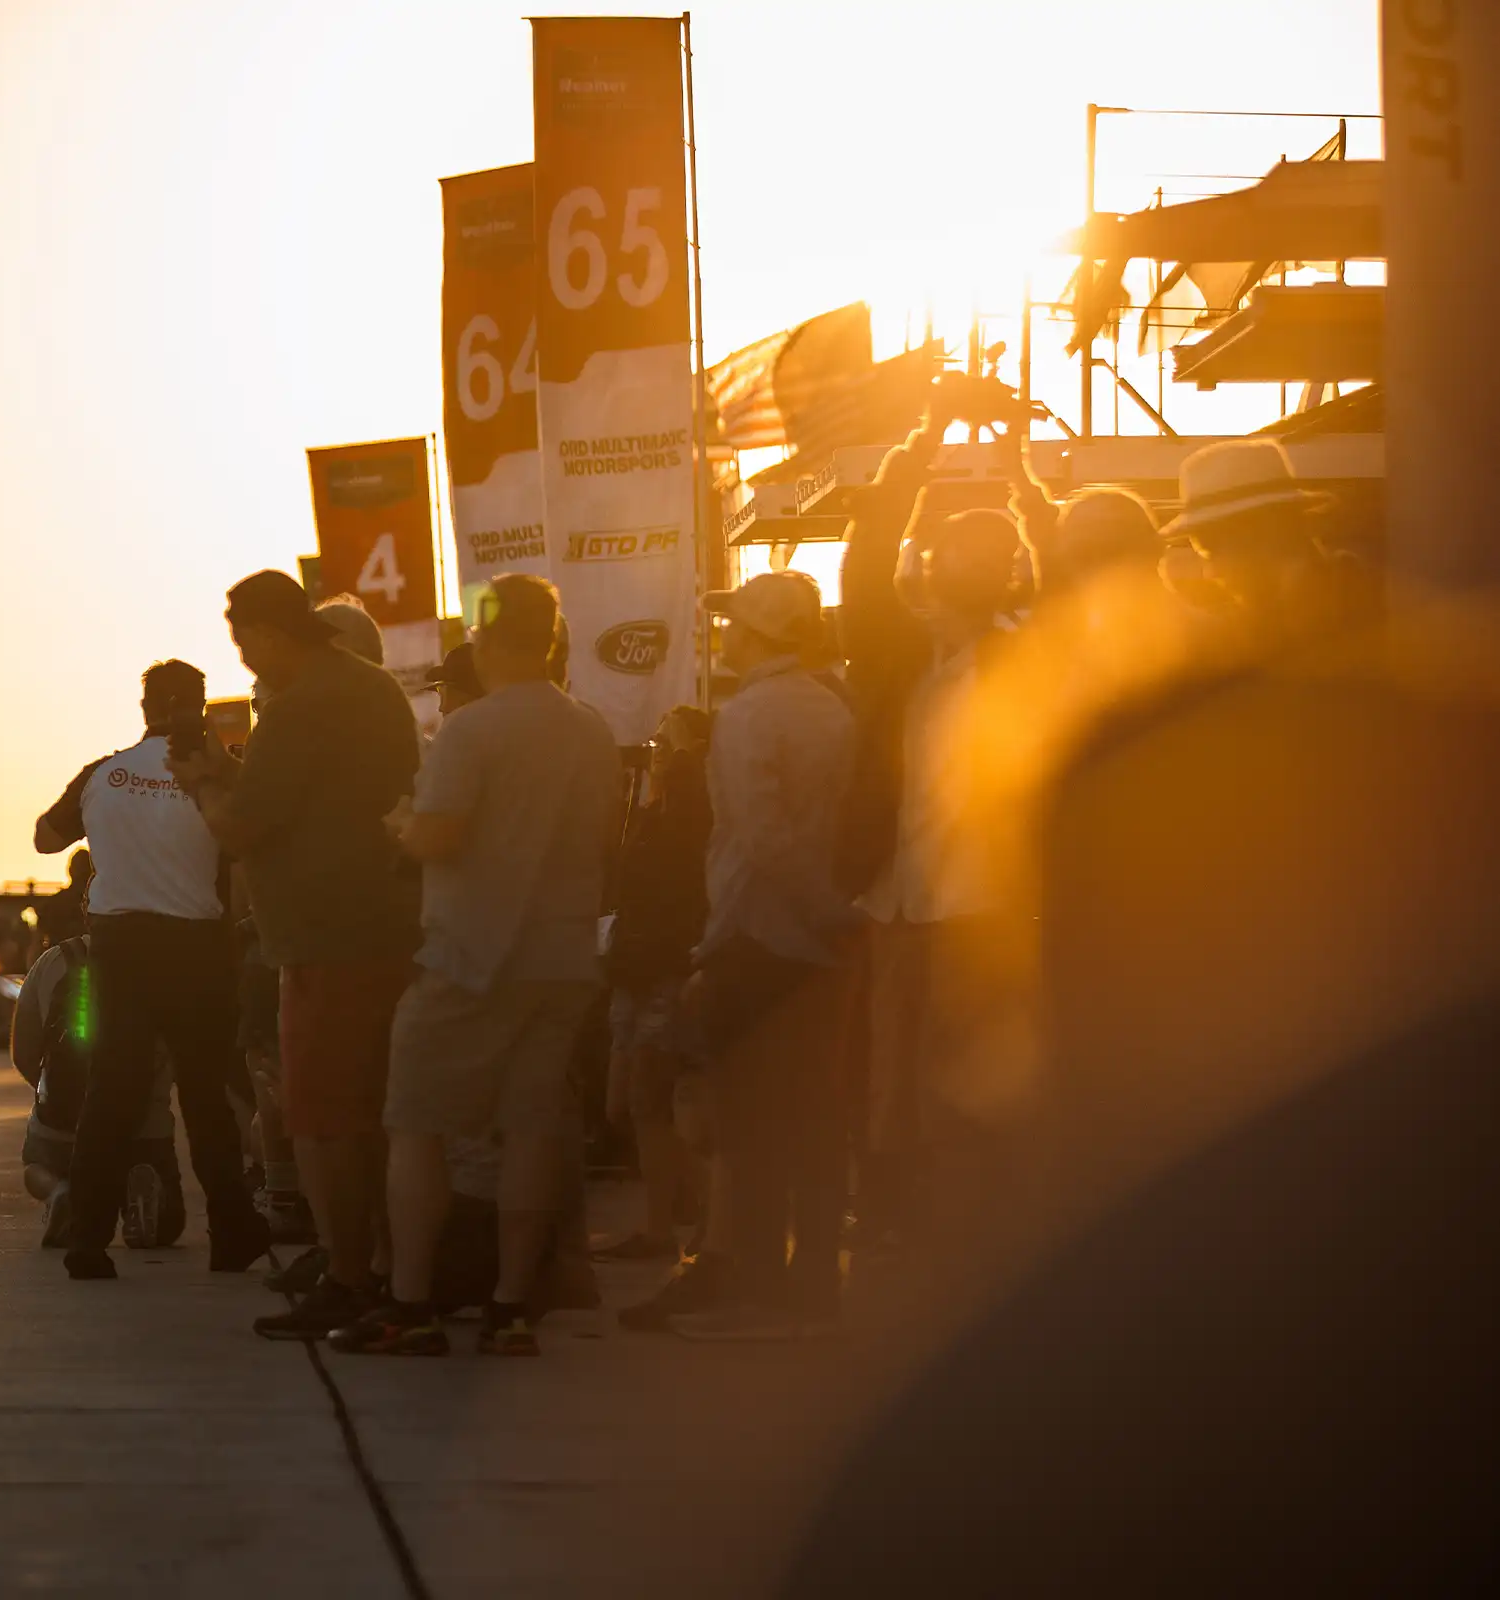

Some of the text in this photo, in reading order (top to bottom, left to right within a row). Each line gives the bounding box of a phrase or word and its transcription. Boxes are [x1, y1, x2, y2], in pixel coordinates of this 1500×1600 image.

[547, 186, 669, 310] 65
[357, 533, 406, 603] 4
[128, 788, 191, 801] RACING
[130, 772, 181, 791] bremb
